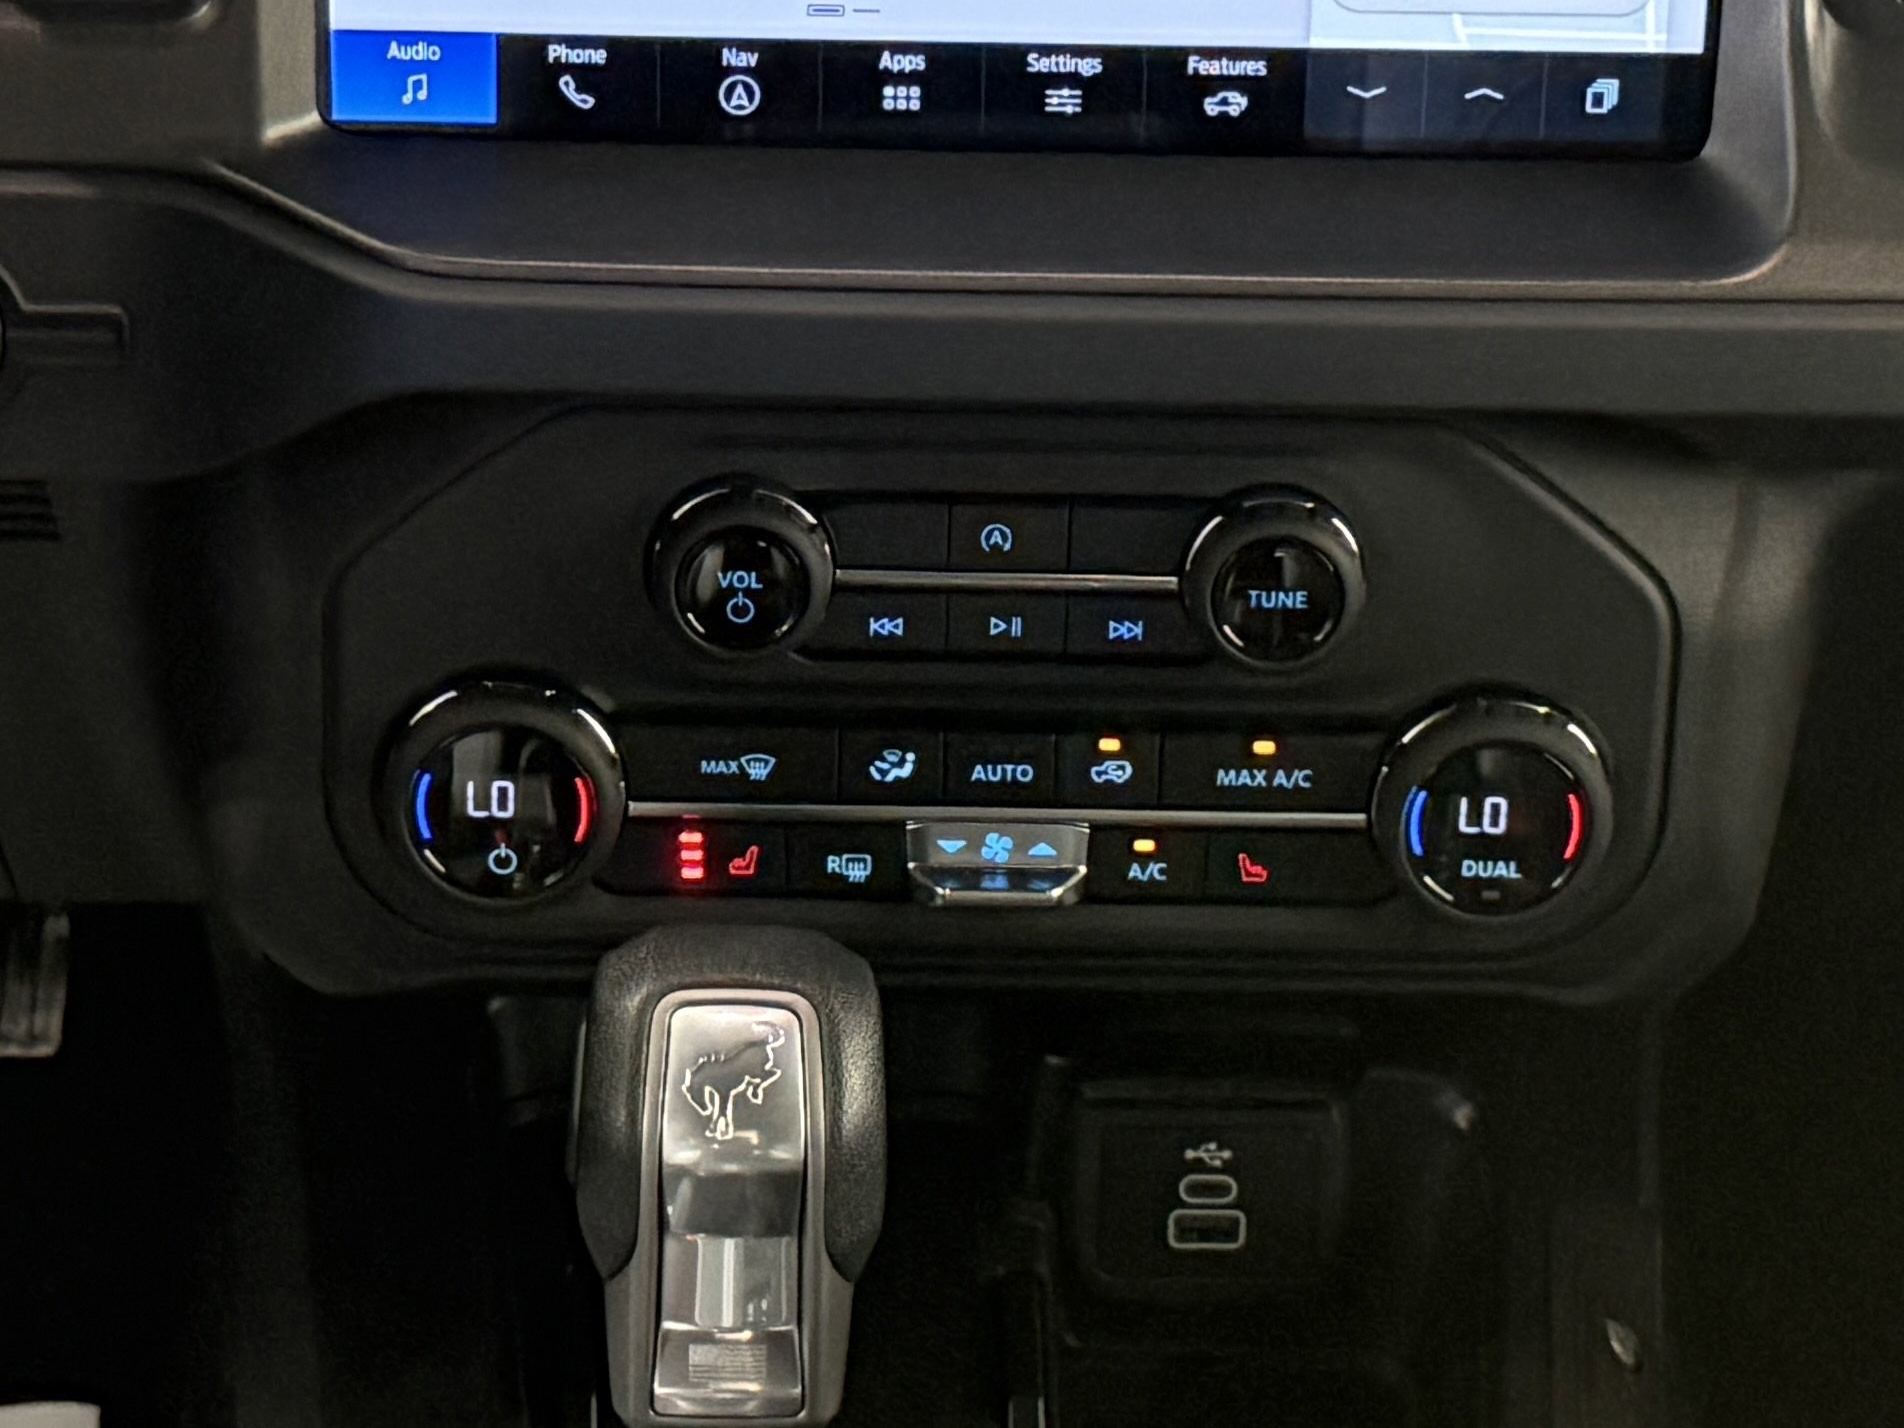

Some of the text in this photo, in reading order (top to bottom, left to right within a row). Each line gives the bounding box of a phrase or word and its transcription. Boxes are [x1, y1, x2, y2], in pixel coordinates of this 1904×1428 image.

[387, 41, 441, 61] Audio
[547, 44, 607, 65] Phone
[722, 47, 758, 68] Nav
[879, 50, 926, 72] Apps
[1026, 54, 1102, 76] Settings
[1188, 54, 1268, 77] Features
[718, 572, 763, 590] VOL
[1248, 589, 1308, 609] TUNE
[701, 759, 739, 775] MAX
[971, 763, 1034, 783] AUTO
[1217, 769, 1313, 789] MAX A/C
[466, 780, 516, 820] LO
[1458, 795, 1508, 835] LO
[1127, 861, 1168, 882] A/C
[1461, 860, 1521, 879] DUAL
